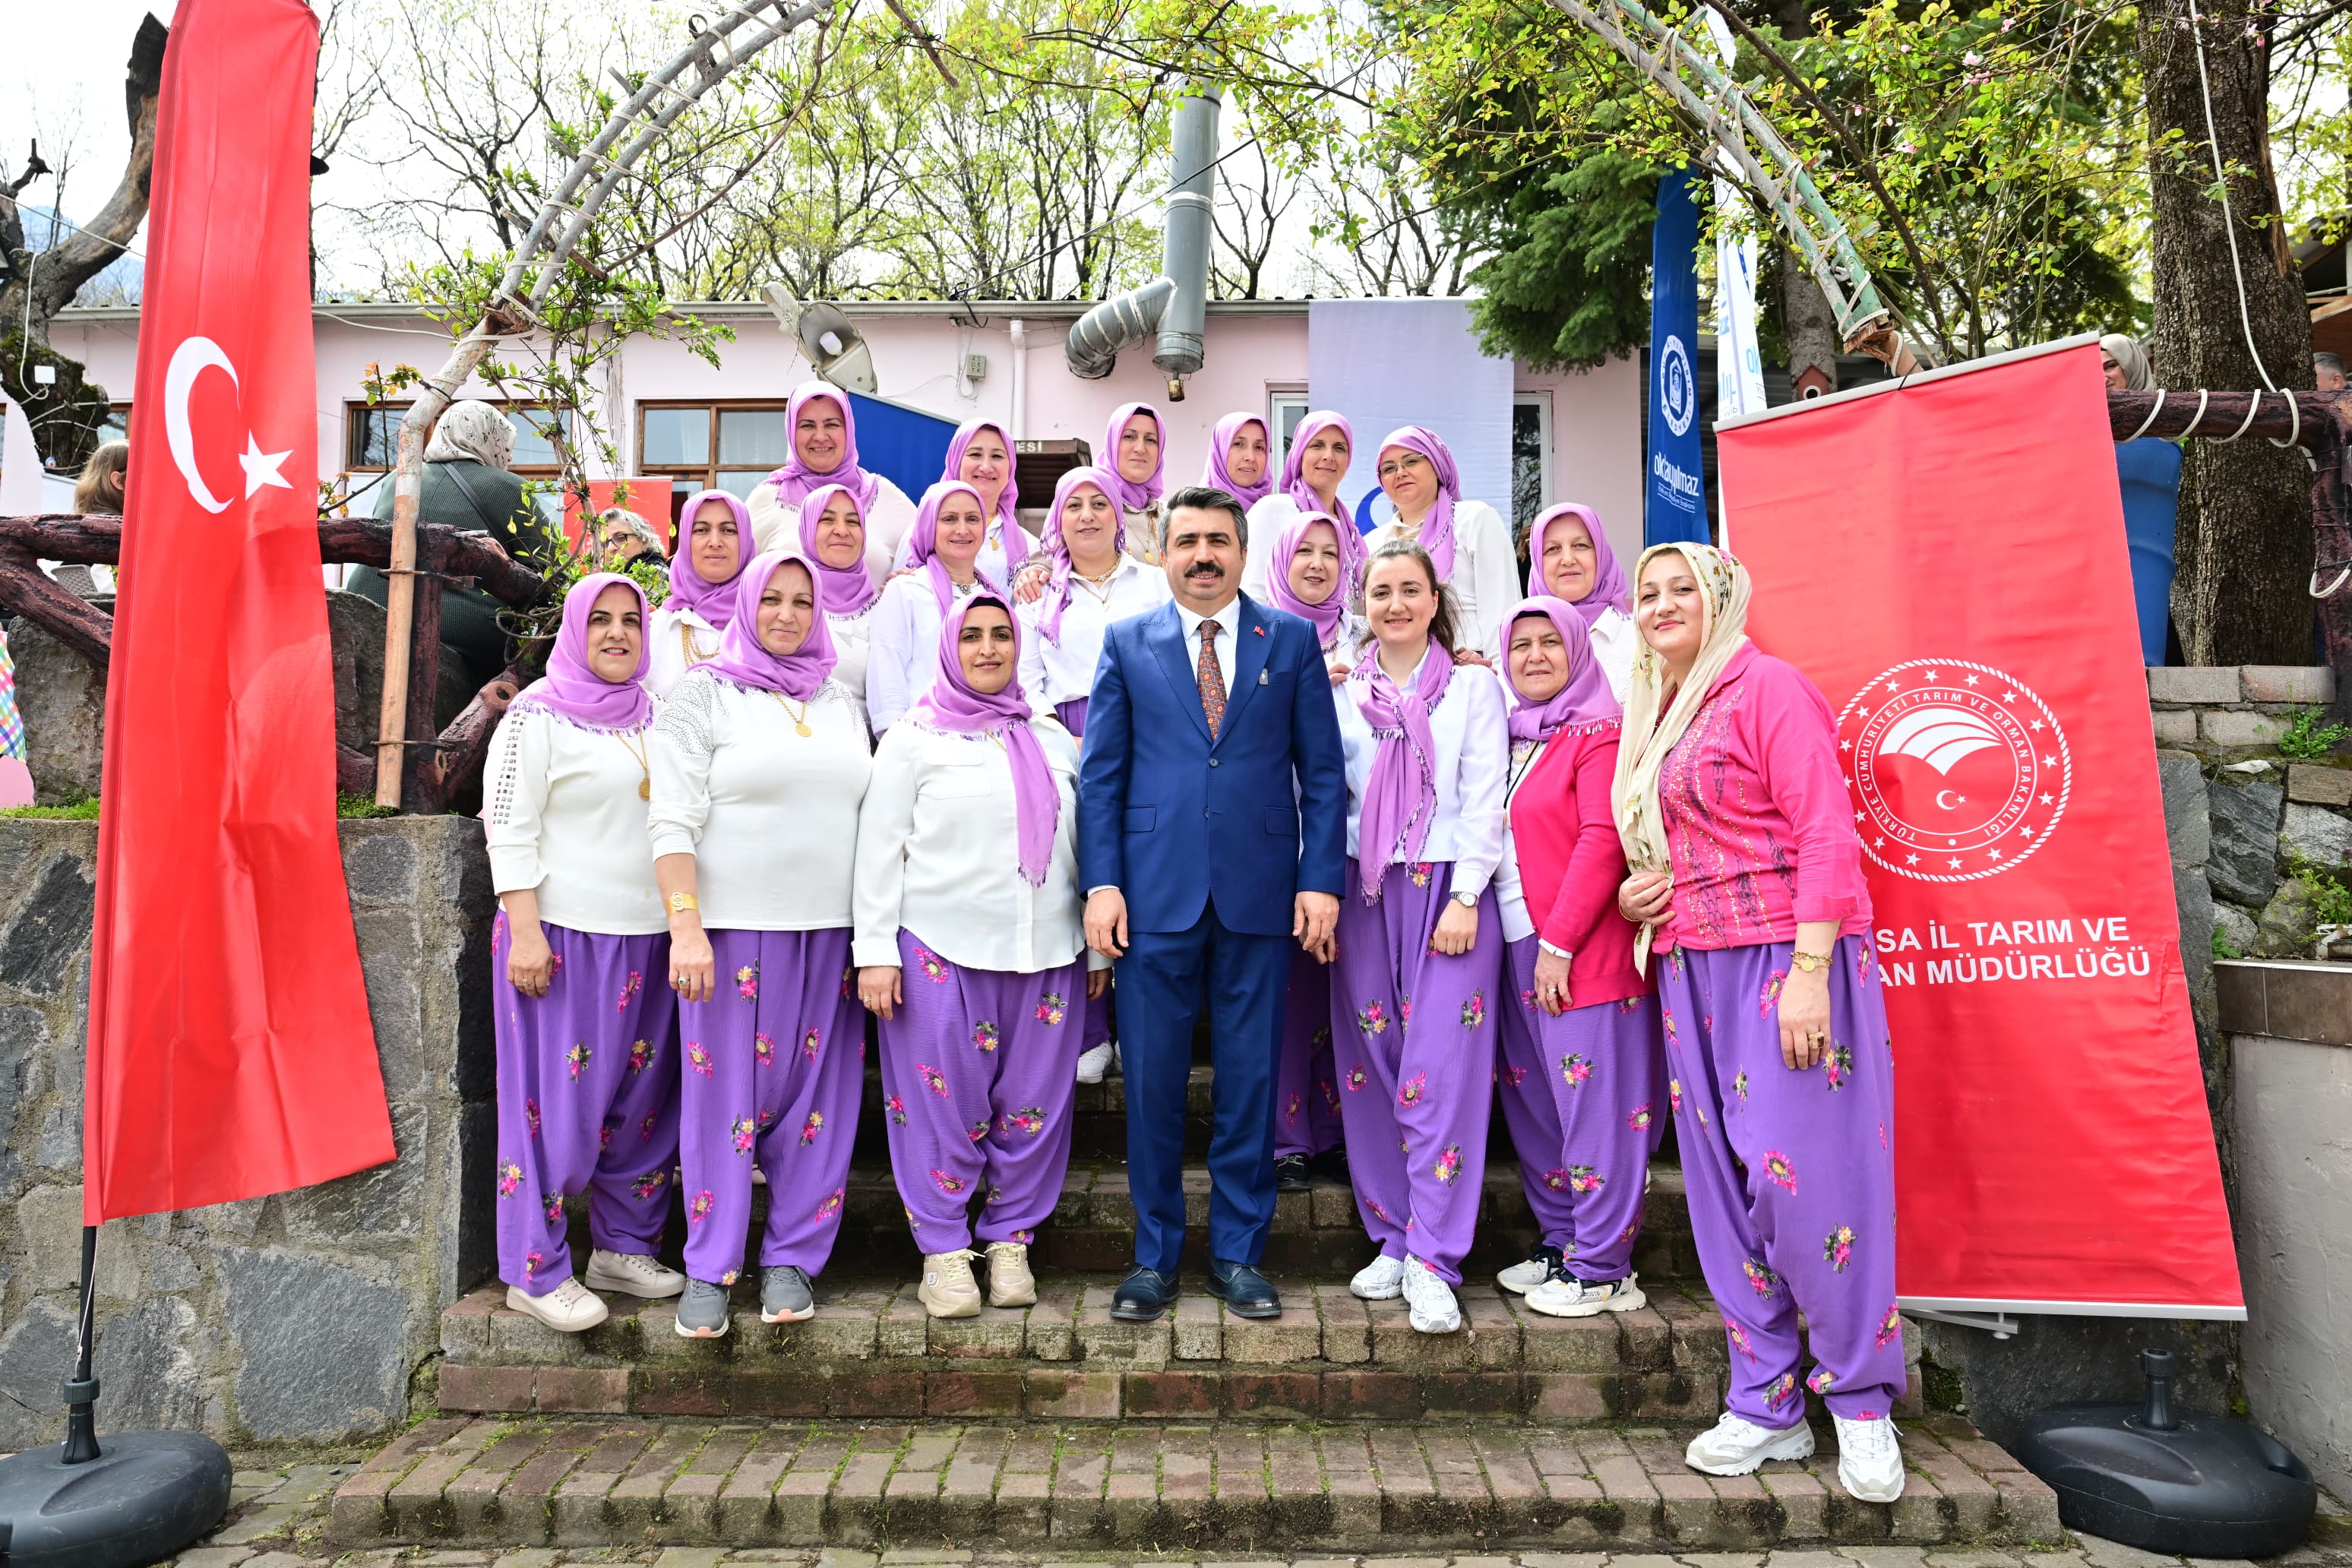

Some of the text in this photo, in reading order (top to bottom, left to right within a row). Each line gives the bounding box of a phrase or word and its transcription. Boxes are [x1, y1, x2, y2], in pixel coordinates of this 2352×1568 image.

[1860, 692, 2031, 841] TÜRKİYE CUMHURİYETİ TARIM VE ORMAN BAKANLIĞI
[1929, 919, 1960, 950] İL
[1968, 918, 2073, 947] TARIM
[2081, 917, 2129, 943] VE
[1927, 946, 2150, 985] MÜDÜRLÜĞÜ
